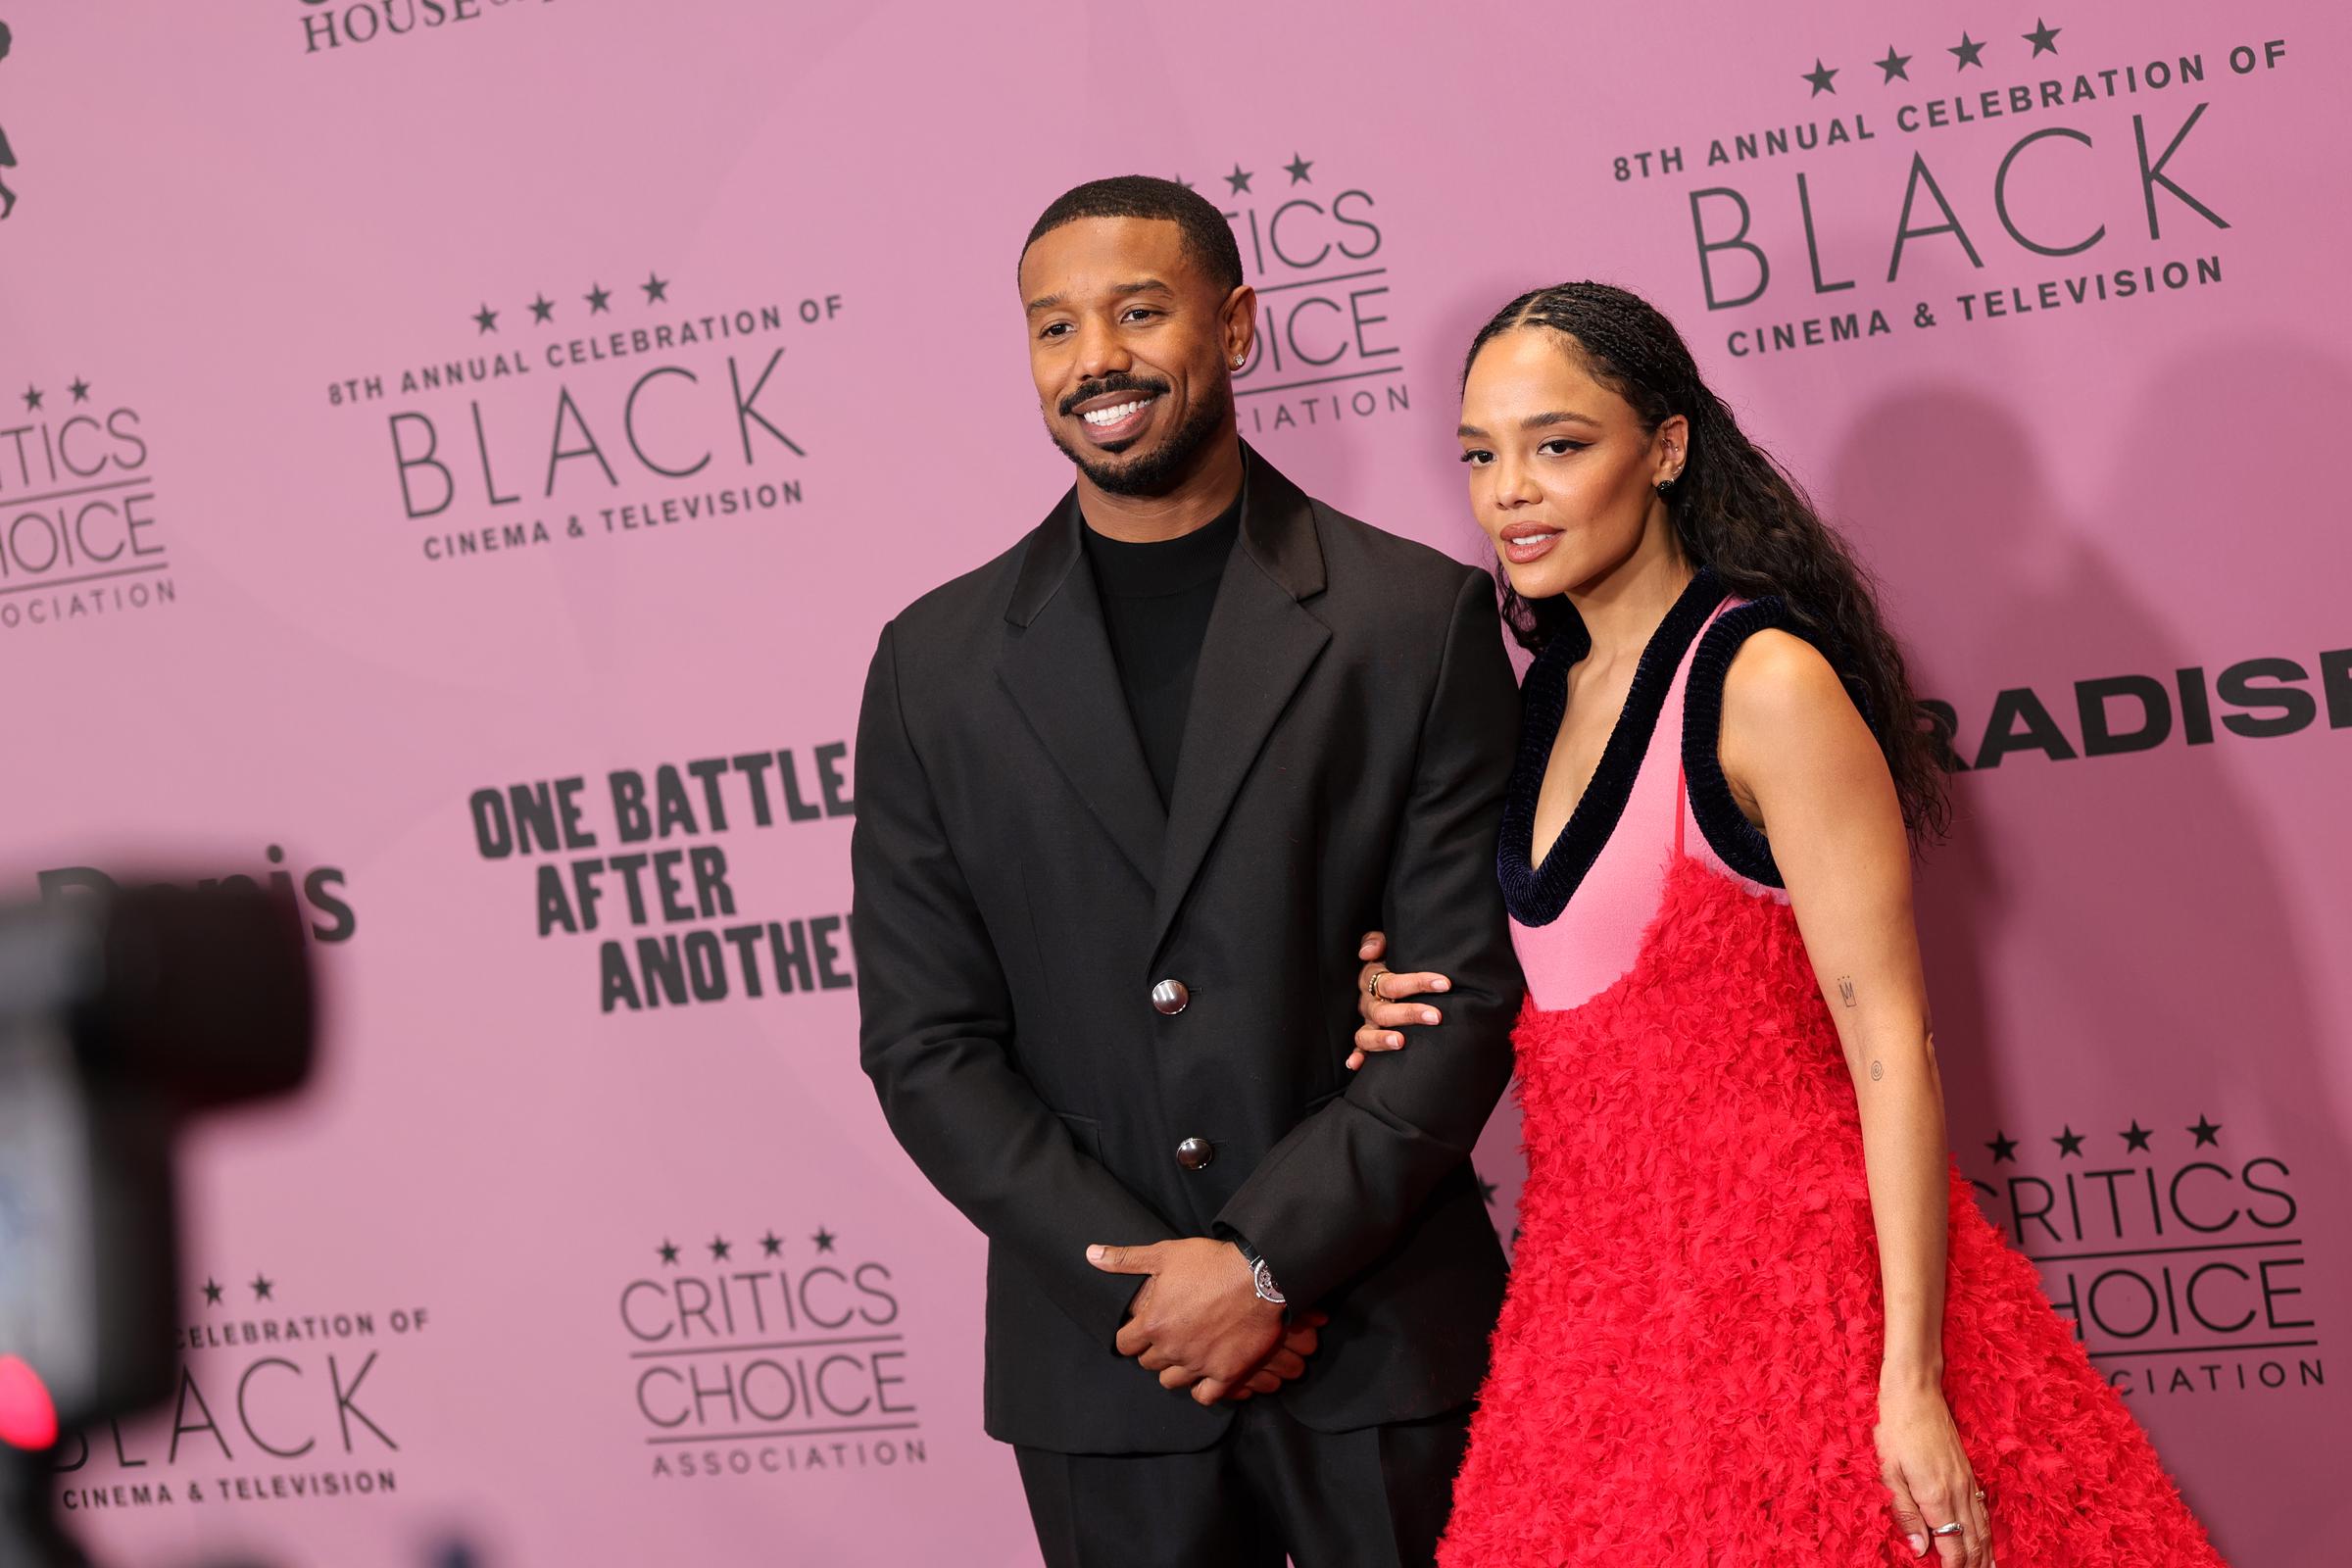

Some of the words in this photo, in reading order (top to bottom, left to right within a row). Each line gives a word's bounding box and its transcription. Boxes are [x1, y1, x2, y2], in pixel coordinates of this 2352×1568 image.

[1613, 146, 1684, 182] 8TH
[1707, 115, 1875, 167] ANNUAL
[1897, 55, 2204, 132] CELEBRATION
[2230, 39, 2287, 74] OF
[1225, 189, 1382, 275] ICS
[1689, 102, 2231, 312] BLACK
[1727, 310, 1891, 357] CINEMA
[1913, 302, 1937, 329] &
[1957, 256, 2222, 321] TELEVISION
[328, 375, 383, 406] 8TH
[402, 351, 529, 394] ANNUAL
[546, 306, 781, 368] CELEBRATION
[799, 295, 844, 323] OF
[0, 408, 147, 487] TICS
[388, 347, 807, 519] BLACK
[1236, 384, 1410, 435] IATION
[423, 520, 550, 561] CINEMA
[565, 514, 587, 539] &
[600, 480, 803, 532] TELEVISION
[468, 775, 599, 861] ONE
[608, 741, 856, 844] BATTLE
[536, 844, 738, 939] AFTER
[599, 913, 858, 1015] ANOTHE
[1974, 1157, 2297, 1245] RITICS
[390, 1308, 429, 1334] OF
[621, 1262, 899, 1343] CRITICS
[636, 1350, 916, 1429] CHOICE
[63, 1484, 172, 1509] CINEMA
[186, 1480, 205, 1503] &
[219, 1471, 397, 1500] TELEVISION
[653, 1440, 926, 1477] ASSOCIATION
